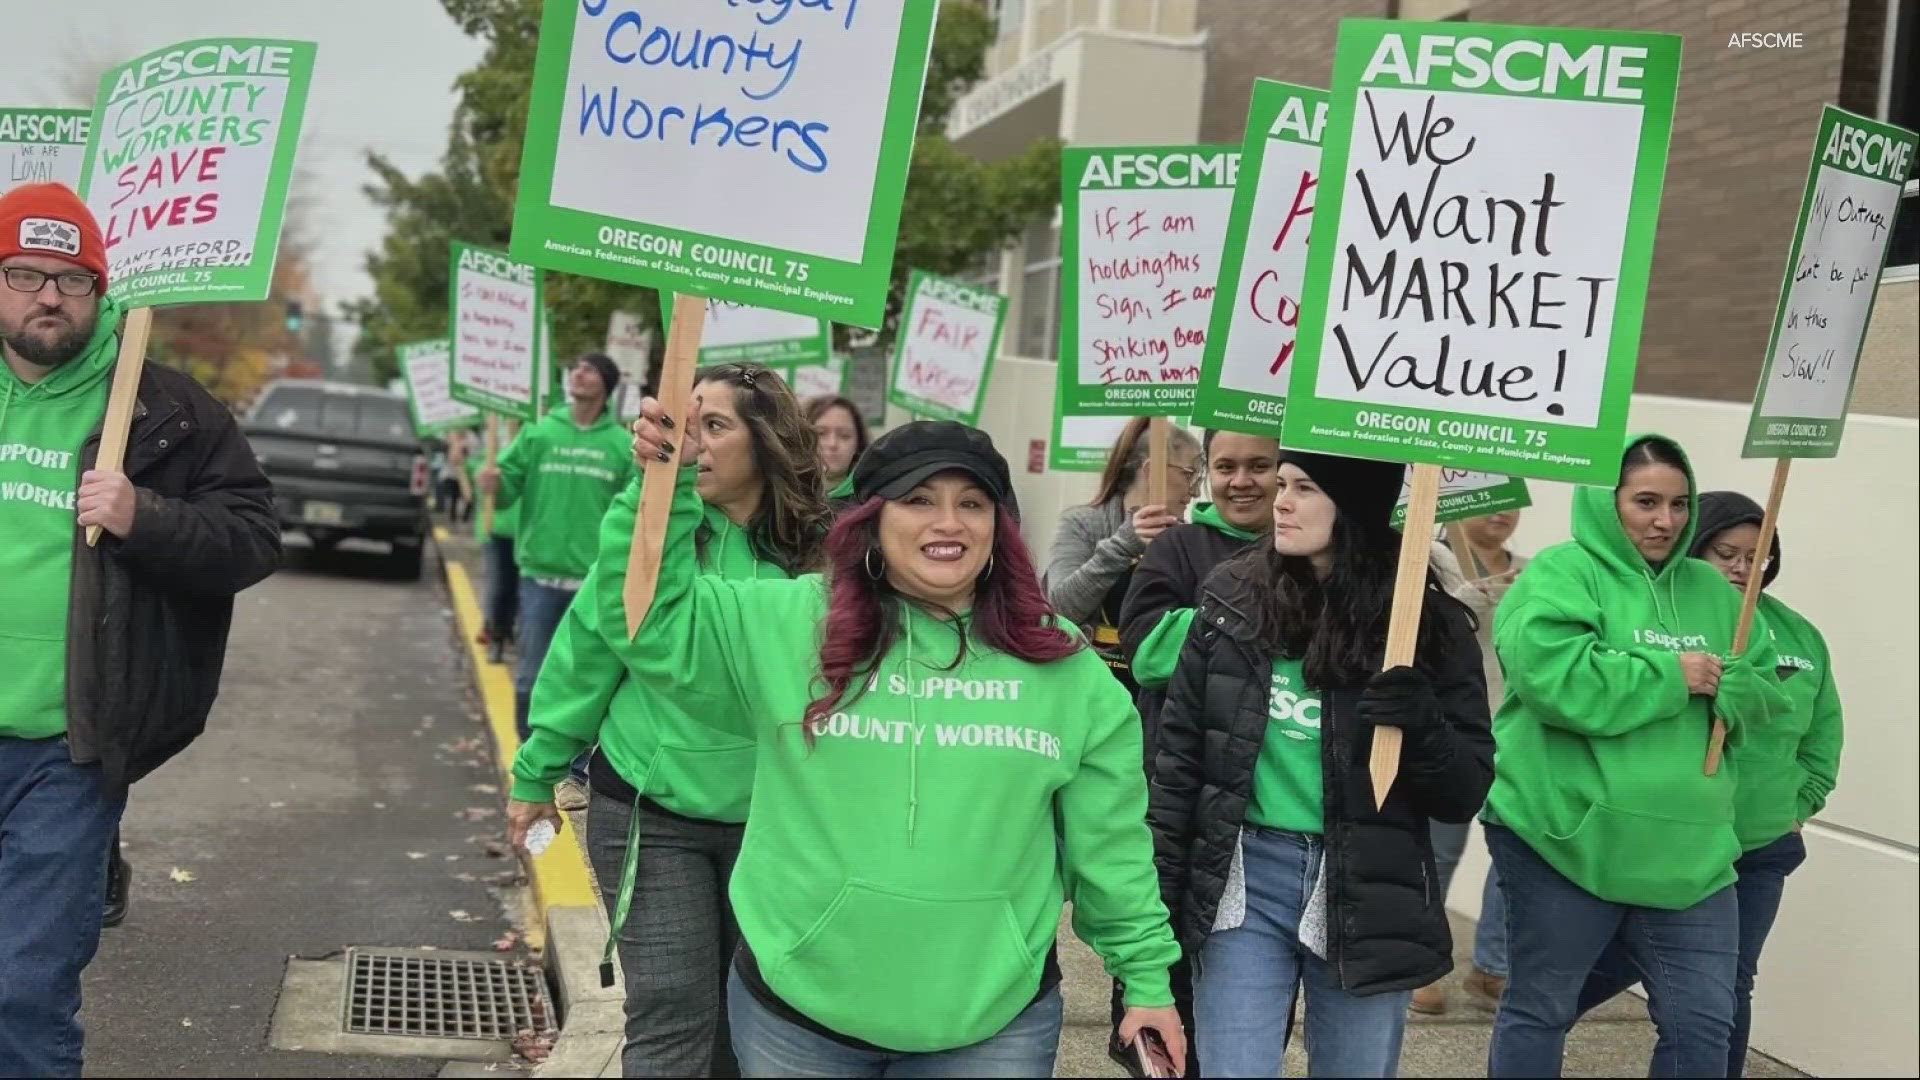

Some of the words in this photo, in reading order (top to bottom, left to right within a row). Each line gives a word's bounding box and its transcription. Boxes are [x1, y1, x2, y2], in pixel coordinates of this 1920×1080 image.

[110, 43, 293, 101] AFSCME
[605, 11, 802, 101] County
[1360, 32, 1648, 100] AFSCME
[0, 113, 91, 143] AFSCME
[115, 81, 266, 140] COUNTY
[579, 83, 830, 174] Workers
[1364, 89, 1476, 166] We
[103, 116, 271, 175] WORKERS
[1079, 153, 1242, 188] AFSCME
[1821, 120, 1912, 182] AFSCME
[111, 146, 226, 209] SAVE
[104, 193, 219, 249] LIVES
[1095, 206, 1120, 243] If
[1127, 209, 1150, 241] I
[1162, 214, 1194, 233] am
[1355, 164, 1565, 257] Want
[161, 239, 241, 258] AFFORD
[459, 248, 535, 283] AFSCME
[544, 239, 592, 257] American
[595, 248, 649, 268] Federation
[651, 260, 664, 270] of
[695, 267, 730, 285] County
[733, 276, 752, 286] and
[754, 279, 801, 297] Municipal
[803, 287, 855, 306] Employees
[598, 225, 683, 259] OREGON
[690, 242, 777, 277] COUNCIL
[784, 259, 810, 282] 75
[131, 273, 188, 290] COUNCIL
[194, 271, 212, 283] 75
[1162, 289, 1187, 312] I
[1342, 244, 1615, 338] MARKET
[1099, 366, 1123, 386] I
[1124, 367, 1153, 384] am
[1104, 388, 1150, 400] OREGON
[1332, 324, 1568, 416] Value!
[1310, 425, 1351, 439] American
[1353, 430, 1400, 445] Federation
[1402, 437, 1413, 445] of
[1442, 440, 1473, 454] County
[1476, 446, 1494, 455] and
[1496, 447, 1540, 461] Municipal
[1542, 453, 1592, 466] Employees
[1355, 410, 1430, 435] OREGON
[1437, 420, 1517, 444] COUNCIL
[1524, 430, 1548, 447] 75
[888, 673, 1023, 701] SUPPORT
[811, 712, 927, 745] COUNTY
[934, 723, 1062, 761] WORKERS
